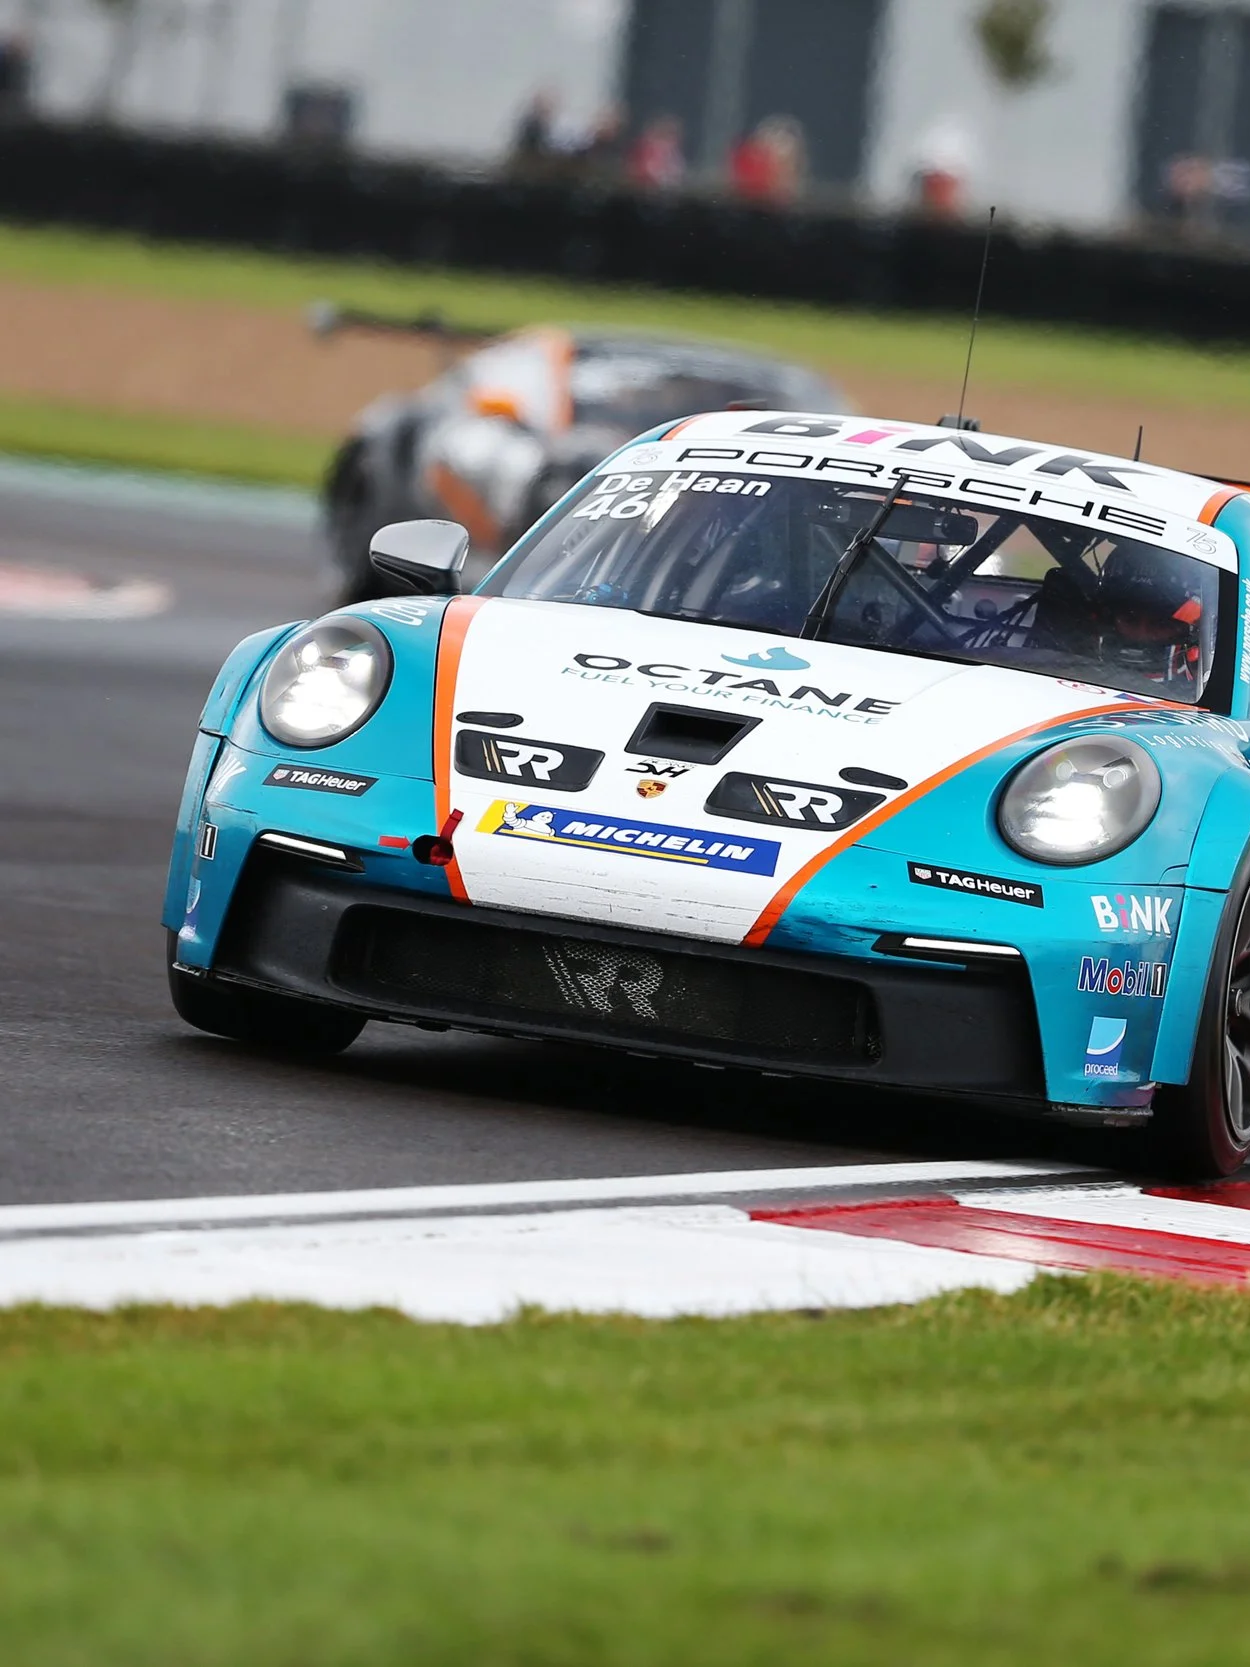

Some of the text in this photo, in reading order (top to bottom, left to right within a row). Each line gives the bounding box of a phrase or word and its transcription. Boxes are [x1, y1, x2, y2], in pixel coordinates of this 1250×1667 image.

[594, 471, 772, 497] De Haan
[676, 447, 1167, 538] PORSCHE
[573, 491, 652, 521] 46
[561, 666, 885, 726] FUEL YOUR FINANCE
[573, 652, 902, 716] OCTANE
[560, 820, 755, 861] MICHELIN
[1090, 894, 1174, 936] BiNK
[1077, 956, 1167, 998] Mobil 1
[1084, 1061, 1119, 1077] proceed
